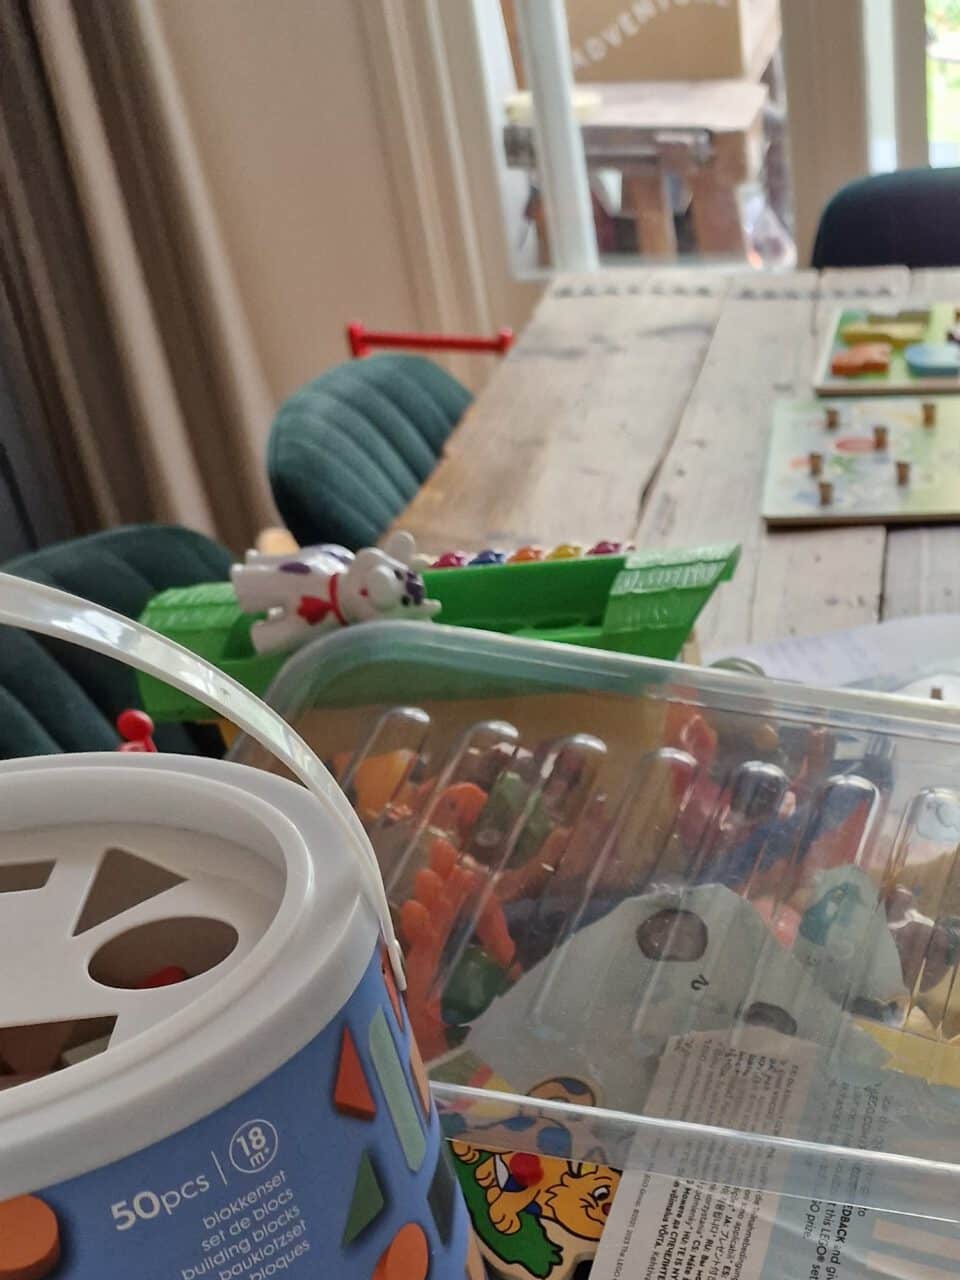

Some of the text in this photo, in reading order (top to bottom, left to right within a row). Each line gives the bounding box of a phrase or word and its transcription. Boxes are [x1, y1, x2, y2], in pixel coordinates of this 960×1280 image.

[236, 1126, 266, 1156] 18
[111, 1176, 210, 1231] 50pcs
[201, 1188, 294, 1251] set de blocs
[202, 1170, 286, 1229] blokkenset
[823, 1208, 834, 1227] this
[181, 1205, 300, 1280] building blocks
[219, 1220, 307, 1280] bauklotzset
[809, 1264, 821, 1280] set
